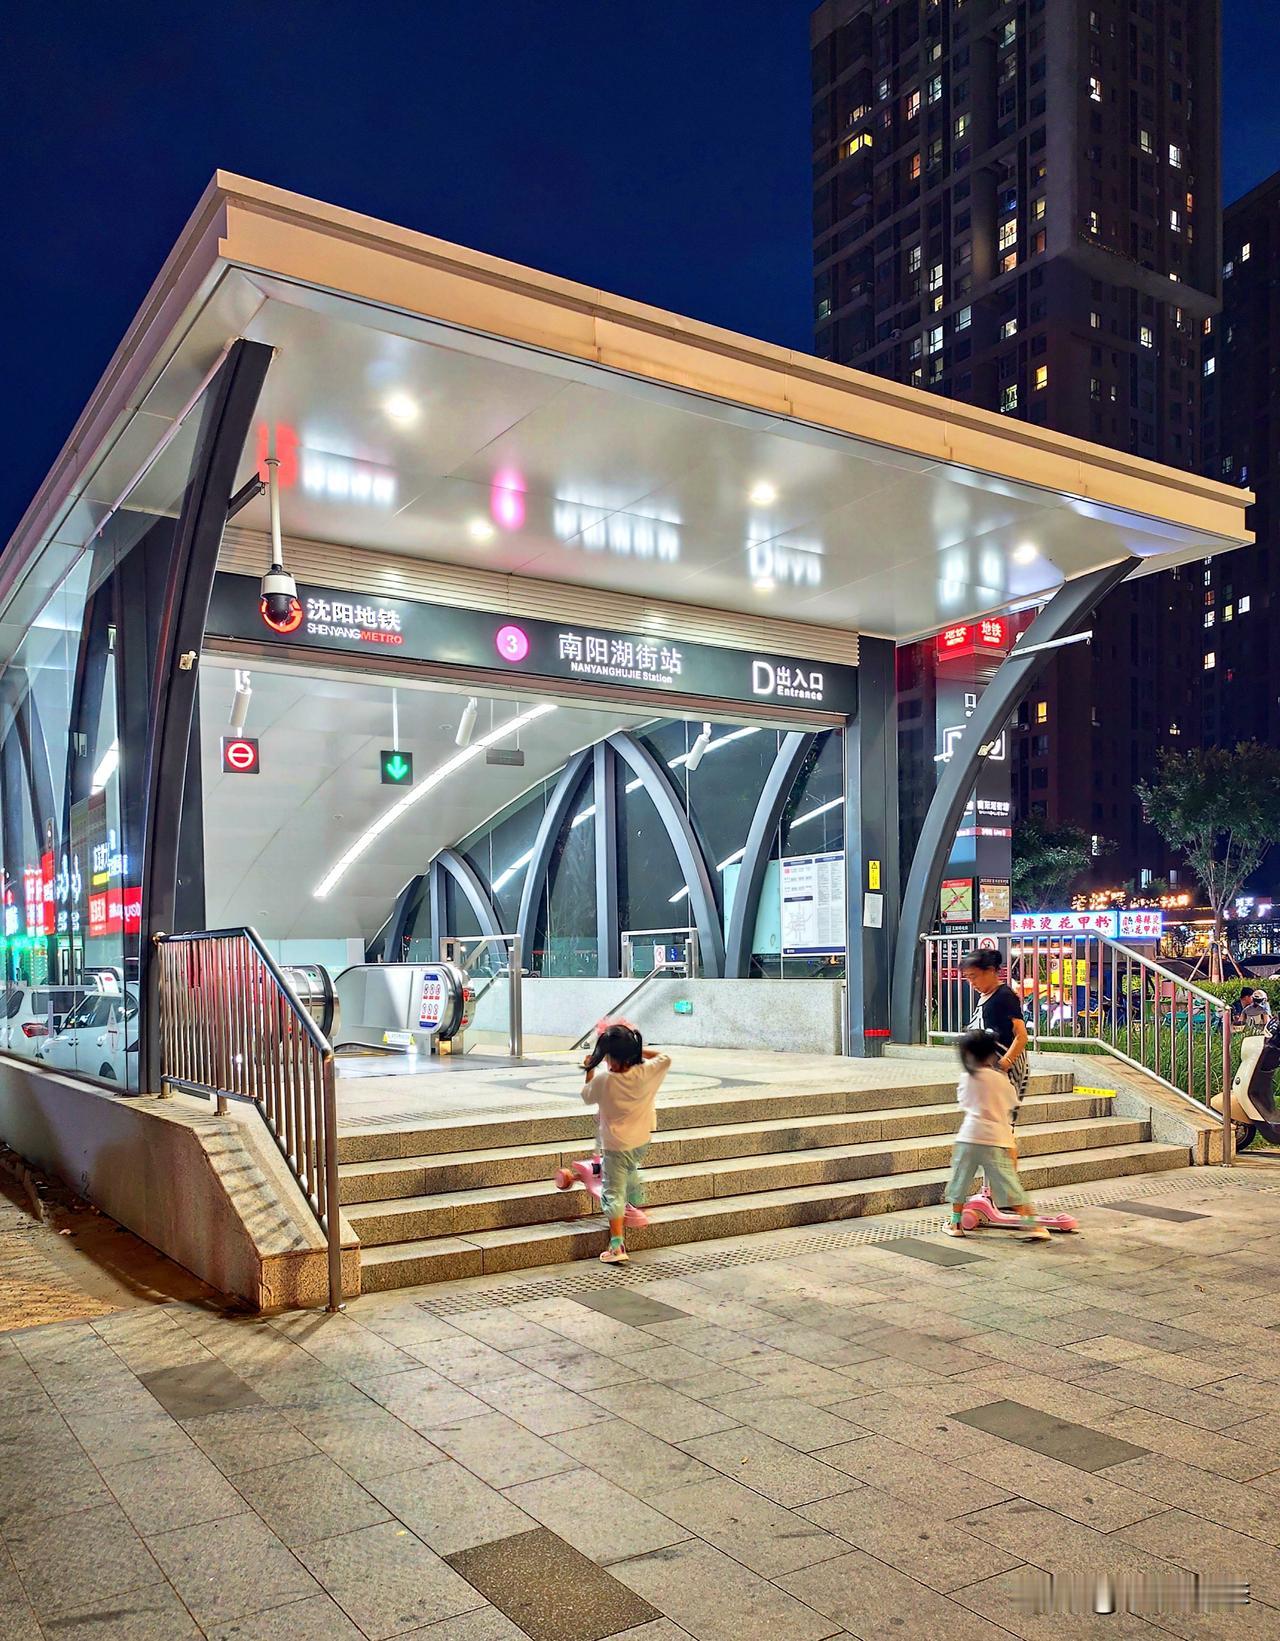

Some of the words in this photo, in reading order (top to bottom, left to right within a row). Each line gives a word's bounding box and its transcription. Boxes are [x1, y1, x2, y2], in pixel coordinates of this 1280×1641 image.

[306, 598, 402, 631] 沈阳地铁
[981, 620, 1002, 638] 地铁
[507, 636, 519, 654] 3
[558, 632, 682, 675] 南阳湖街站
[571, 662, 642, 680] NANYANGHUJIE
[642, 670, 674, 685] Station
[752, 660, 775, 694] D
[777, 666, 824, 691] 出入口
[776, 686, 824, 702] Entrance
